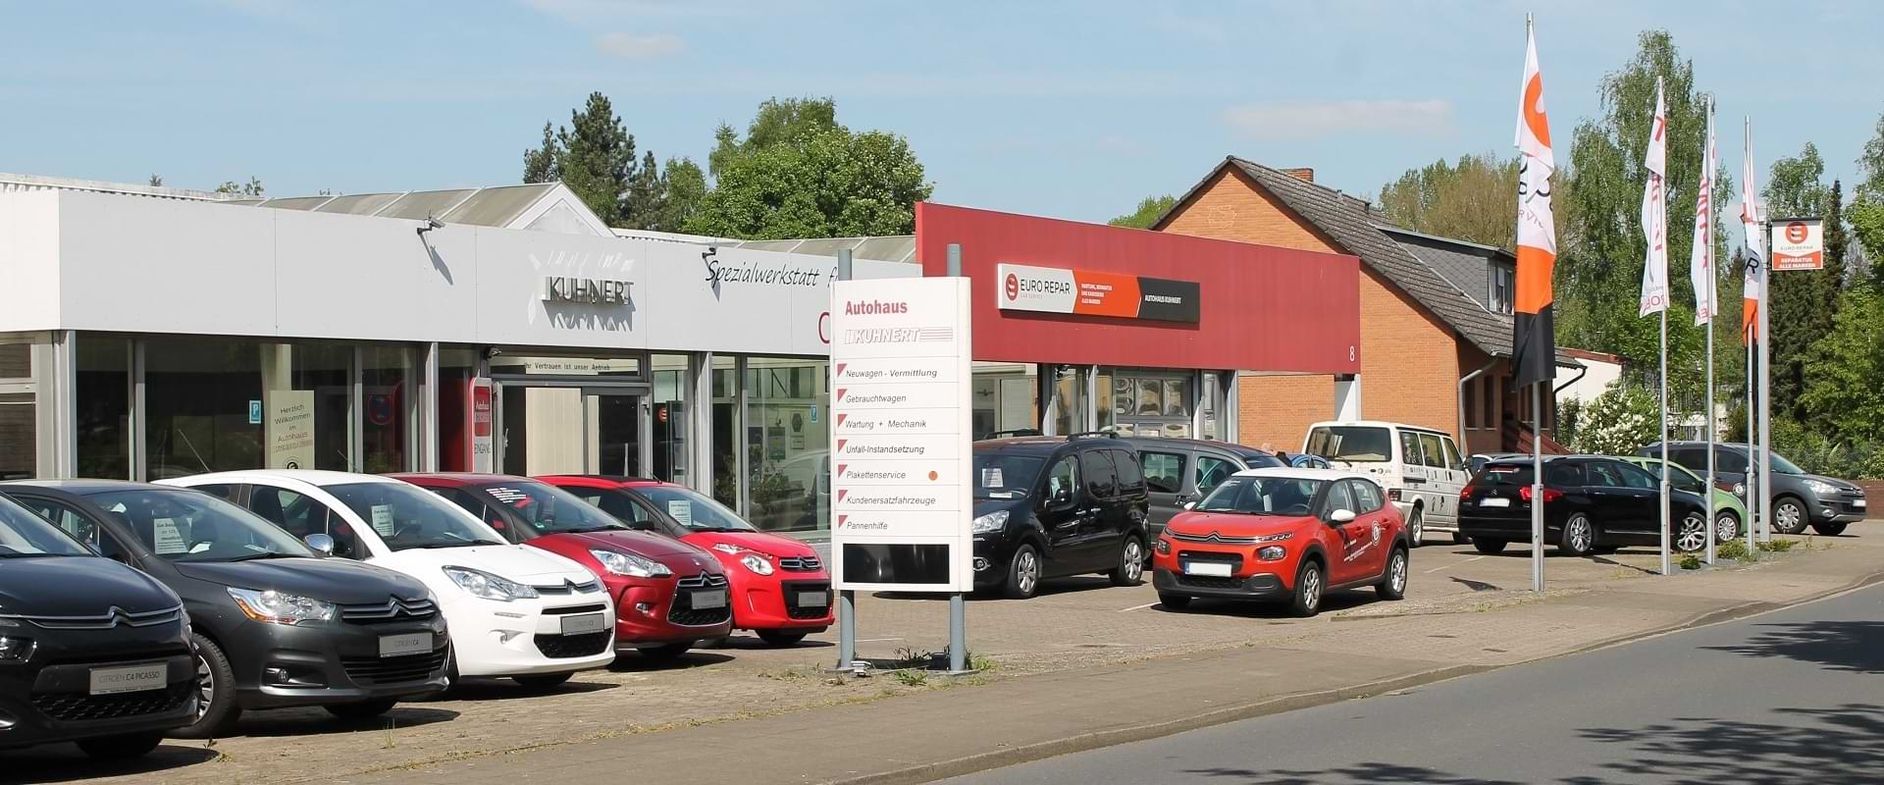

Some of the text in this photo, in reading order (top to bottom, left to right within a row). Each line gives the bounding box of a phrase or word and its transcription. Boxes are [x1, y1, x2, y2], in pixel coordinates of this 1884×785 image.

[705, 260, 820, 288] Spezialwerkstatt
[549, 276, 634, 305] KUHNERT
[1020, 279, 1042, 293] EURO
[1044, 280, 1071, 295] REPAR
[845, 300, 908, 315] Autohaus
[1349, 345, 1355, 361] 8
[535, 362, 561, 370] Vertrauen
[846, 370, 883, 378] Neuwagen
[889, 369, 938, 378] Vermittlung
[846, 395, 907, 404] Gebrauchtwagen
[845, 420, 875, 430] Wartung
[887, 420, 927, 428] Mechanik
[846, 445, 925, 454] Unfall-Instandsetzung
[846, 470, 906, 479] Plakettenservice
[846, 496, 936, 506] Kundenersatzfahrzeuge
[846, 521, 888, 530] Pannenhilfe
